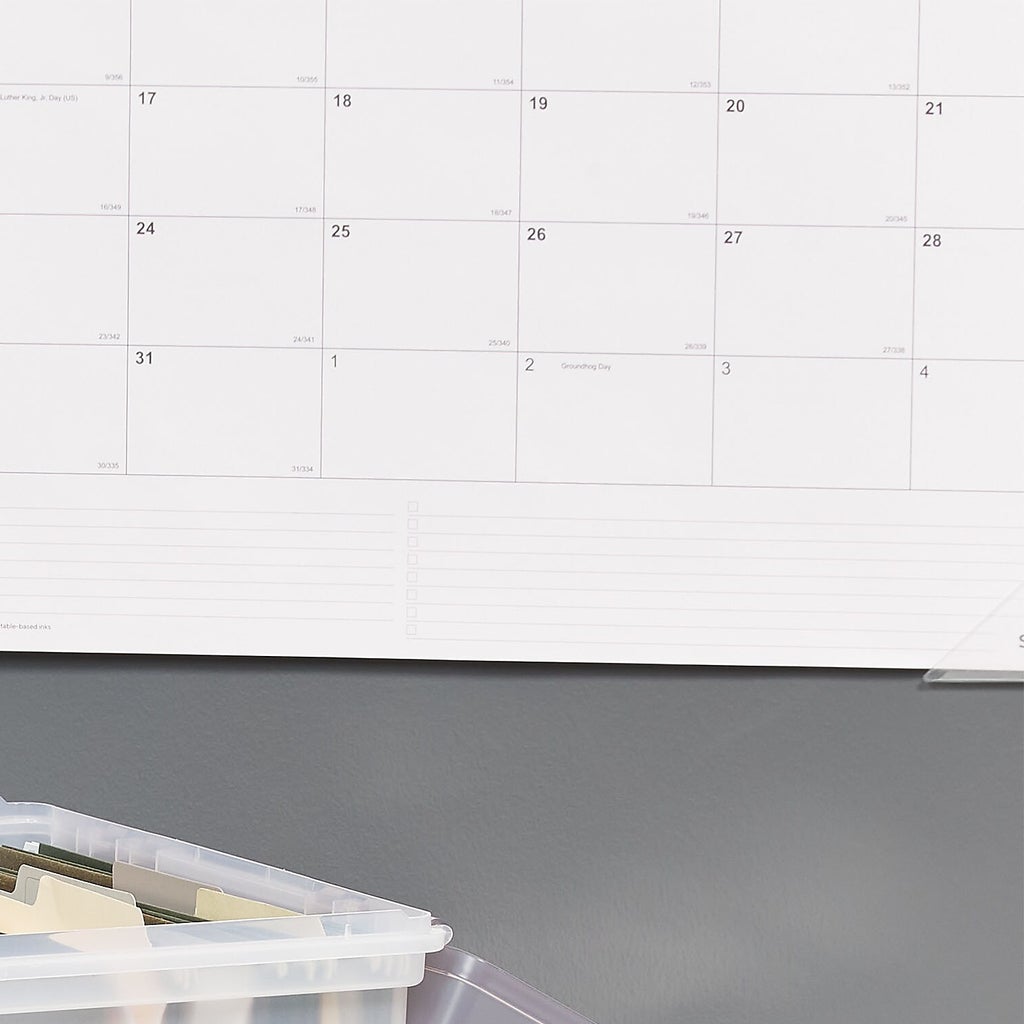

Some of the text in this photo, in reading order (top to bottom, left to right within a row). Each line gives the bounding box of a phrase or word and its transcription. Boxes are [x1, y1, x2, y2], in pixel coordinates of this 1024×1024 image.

[0, 93, 20, 101] Luther
[49, 94, 62, 103] Day
[63, 94, 79, 103] (US)
[138, 92, 157, 105] 17
[333, 94, 352, 108] 18
[529, 96, 548, 110] 19
[726, 99, 746, 113] 20
[925, 102, 943, 115] 21
[136, 222, 156, 235] 24
[331, 225, 351, 238] 25
[527, 228, 547, 242] 26
[724, 231, 744, 245] 27
[923, 234, 943, 248] 28
[135, 352, 154, 365] 31
[331, 355, 337, 368] 1
[524, 358, 535, 372] 2
[560, 362, 612, 372] Groundhog Day
[722, 361, 732, 375] 3
[919, 365, 930, 379] 4
